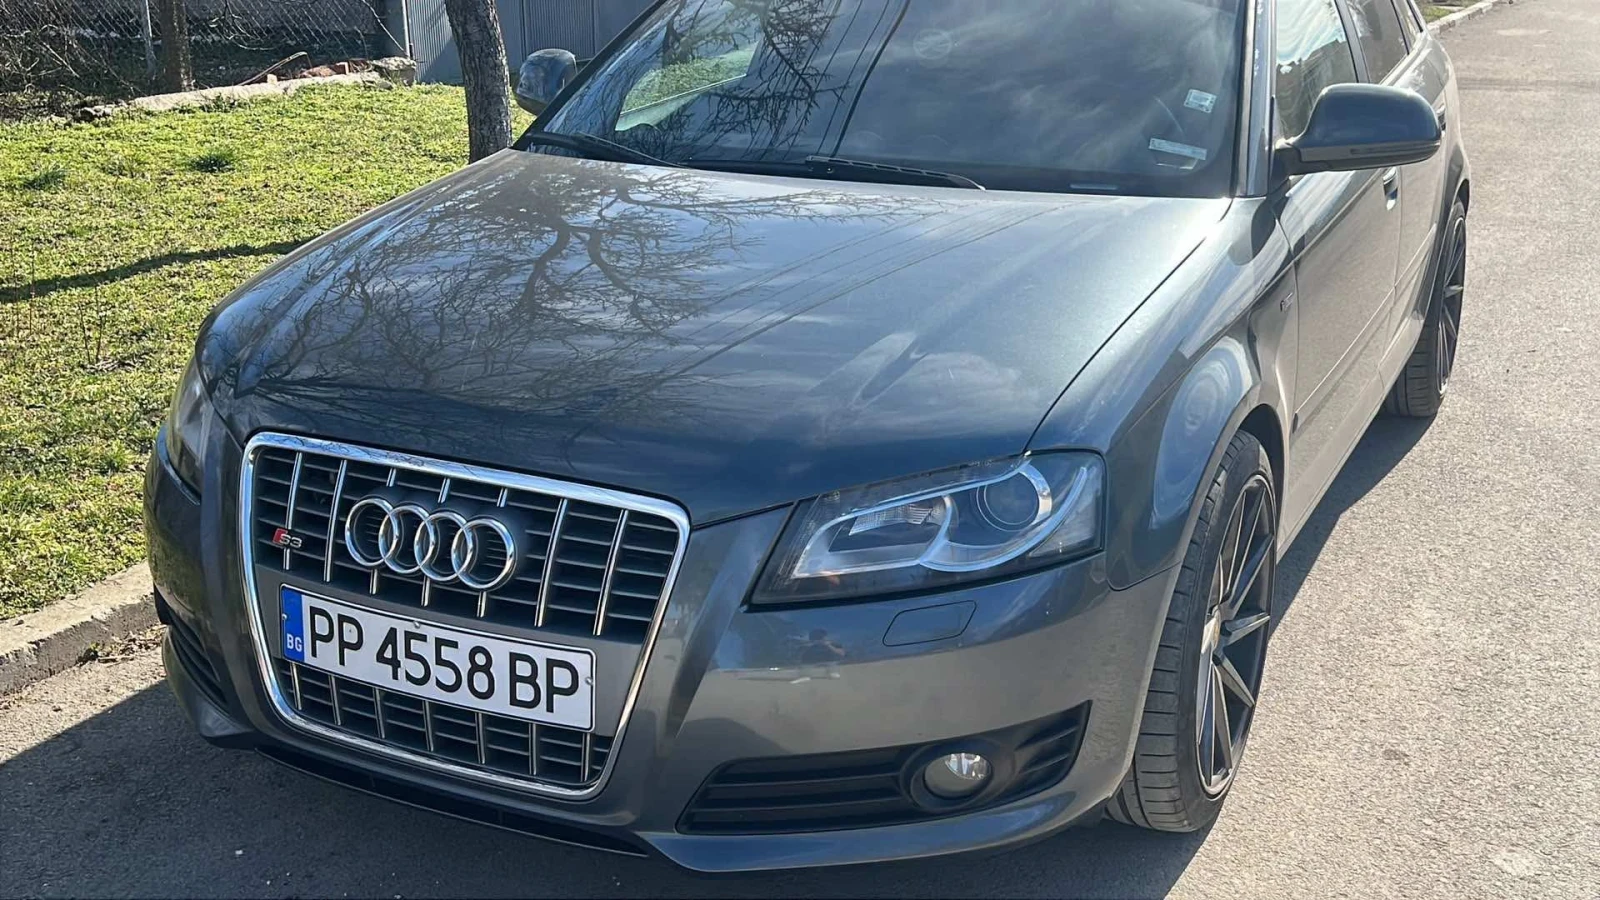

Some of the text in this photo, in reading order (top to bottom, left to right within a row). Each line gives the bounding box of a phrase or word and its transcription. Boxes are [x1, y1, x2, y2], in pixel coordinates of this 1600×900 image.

[280, 533, 302, 548] S3
[286, 632, 303, 652] BG
[309, 606, 579, 713] PP 4558 BP
